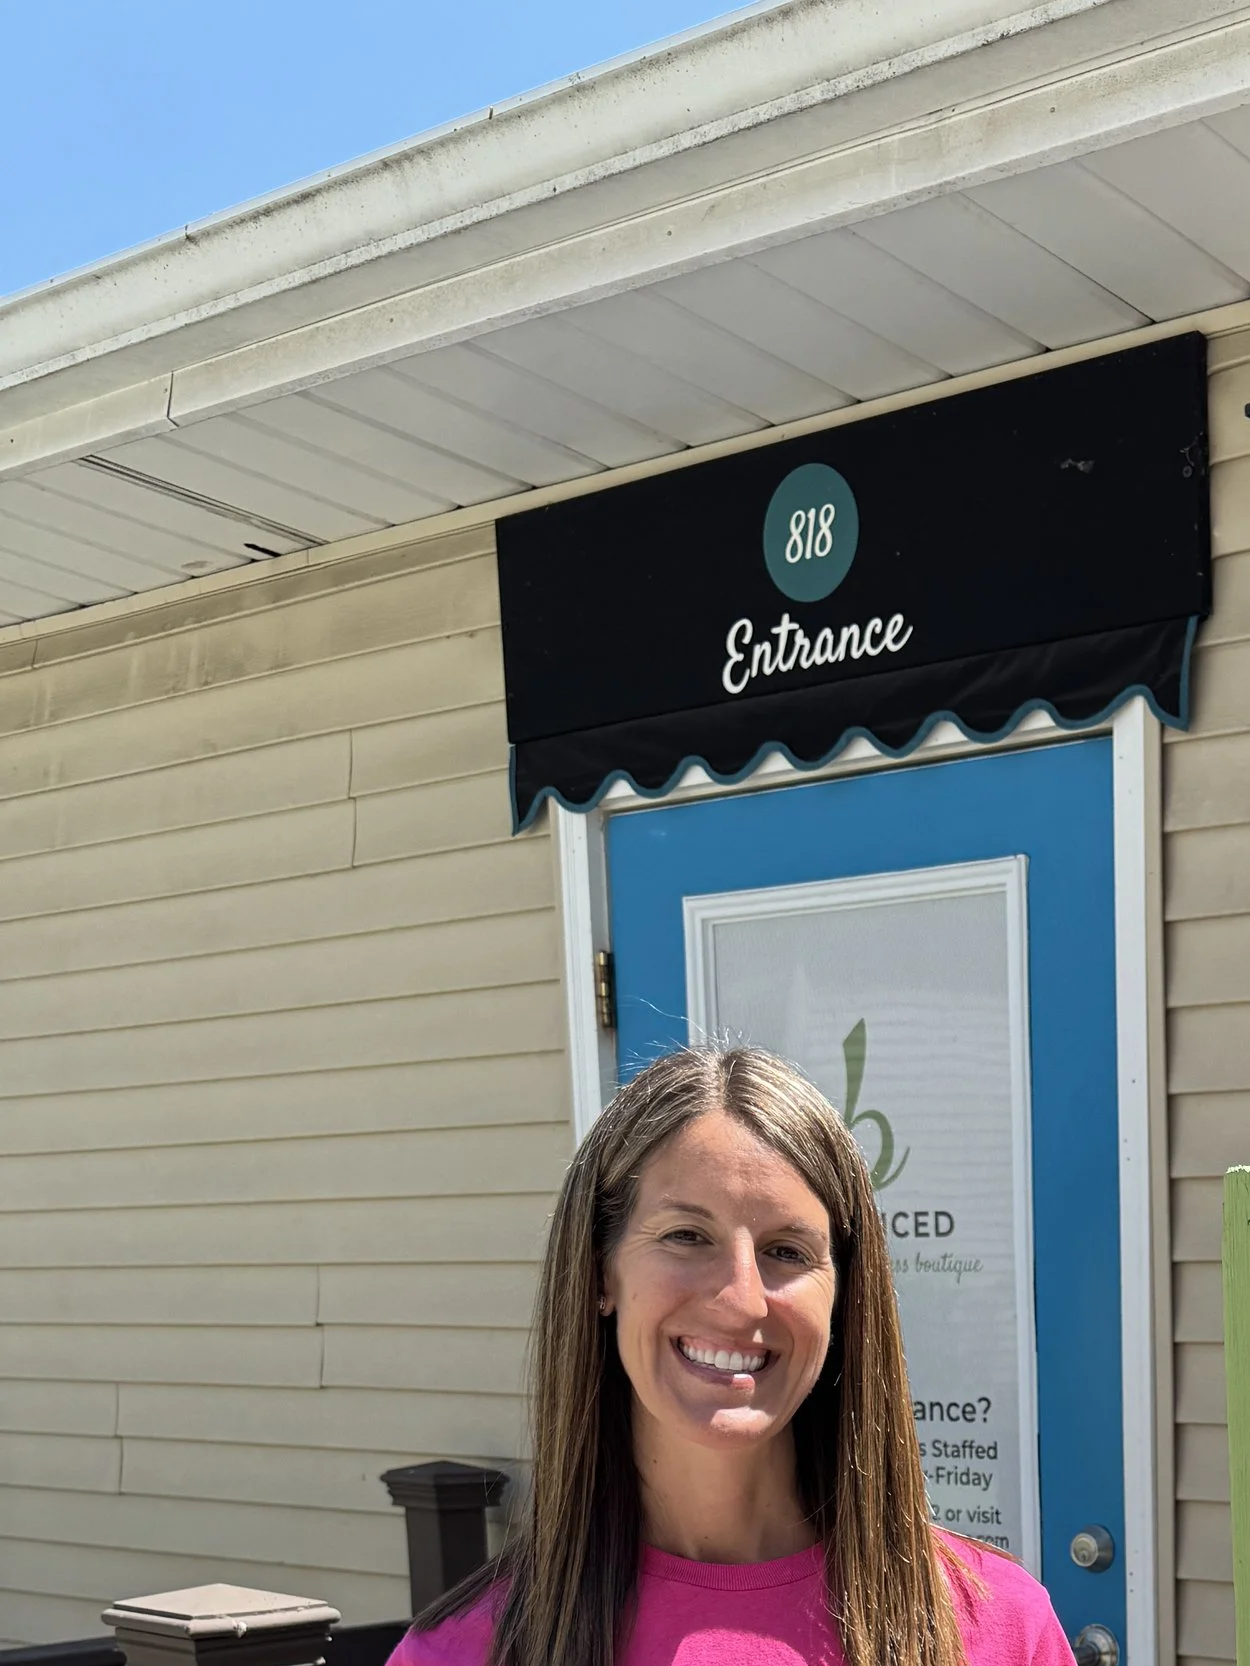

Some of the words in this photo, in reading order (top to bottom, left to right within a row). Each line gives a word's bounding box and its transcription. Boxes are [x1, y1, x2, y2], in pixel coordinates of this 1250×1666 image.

[785, 503, 835, 563] 818
[722, 613, 914, 694] Entrance
[881, 1210, 955, 1238] CED
[915, 1252, 984, 1284] boutique
[913, 1396, 992, 1424] ance?
[931, 1439, 998, 1460] Staffed
[924, 1466, 993, 1492] -Friday
[945, 1509, 963, 1523] or
[967, 1505, 1003, 1525] visit
